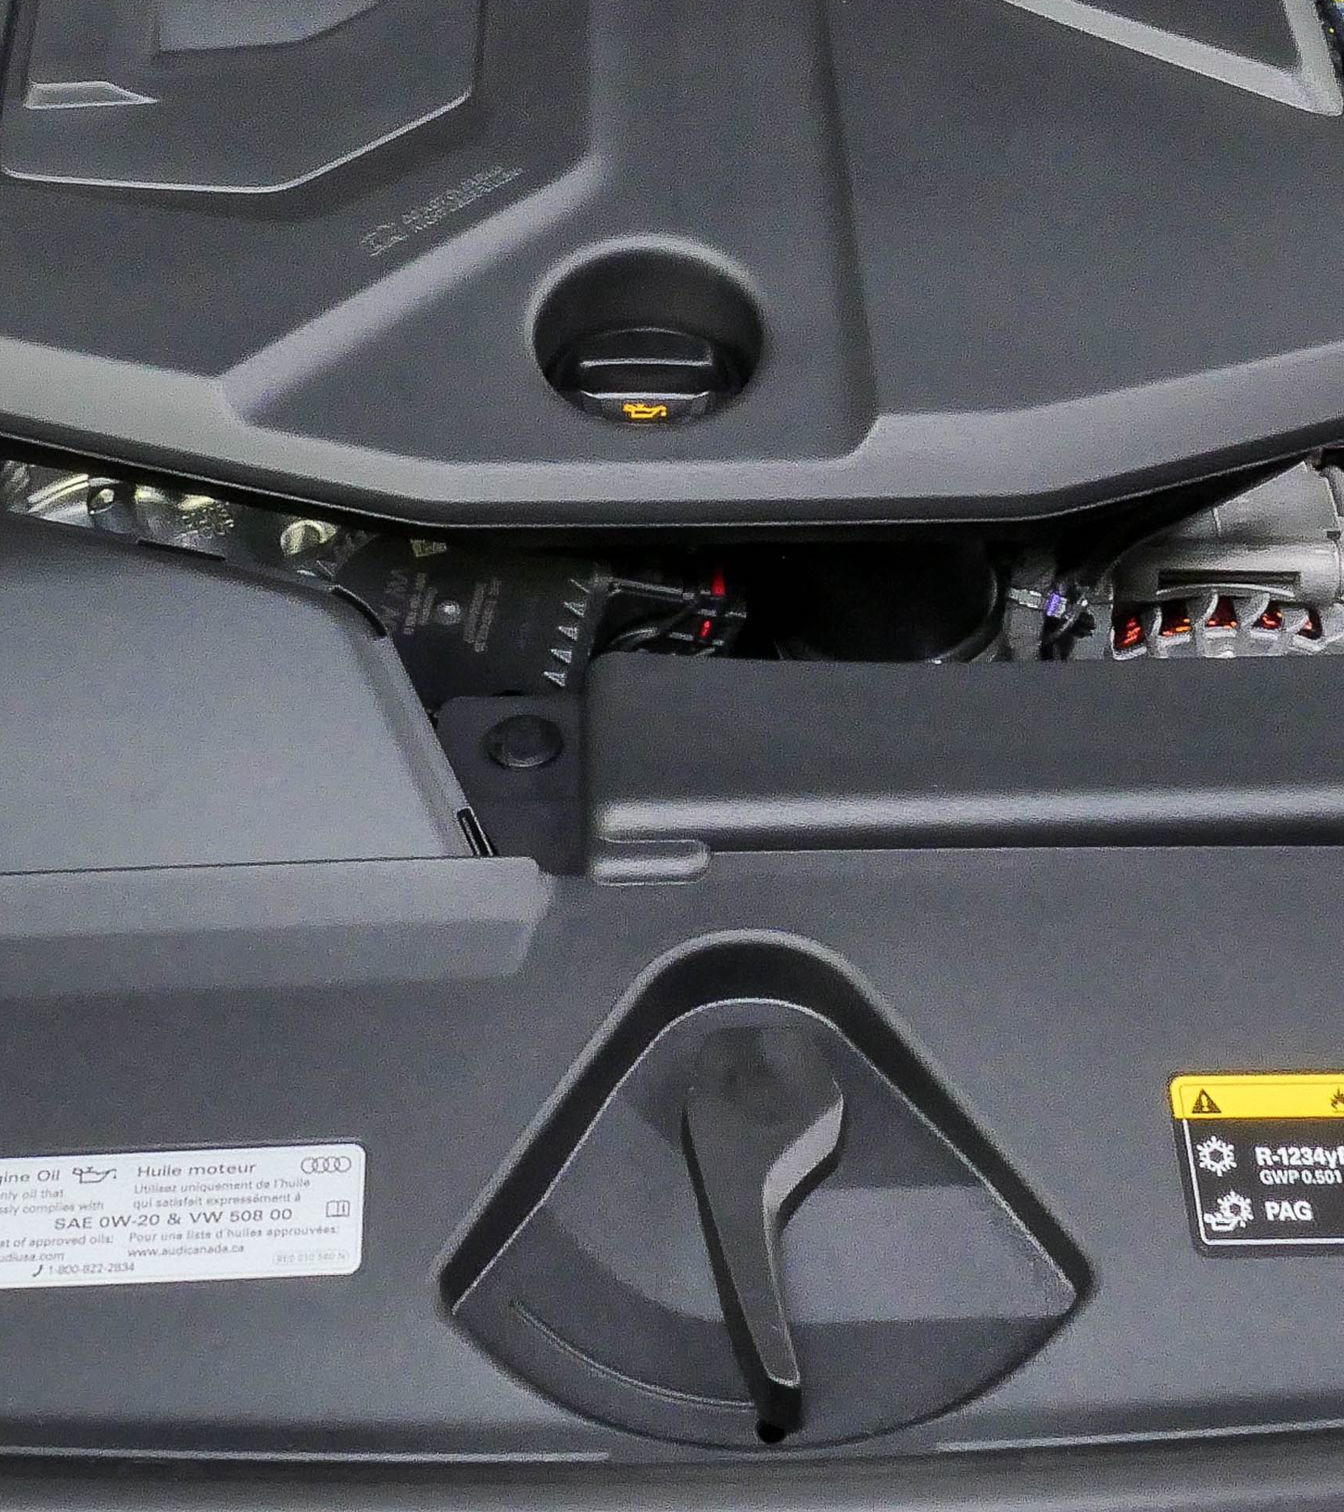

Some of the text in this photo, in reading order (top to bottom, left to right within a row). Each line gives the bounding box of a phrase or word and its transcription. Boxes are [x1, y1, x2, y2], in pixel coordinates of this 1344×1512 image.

[37, 1170, 60, 1183] Oil
[137, 1163, 256, 1177] Huile moteur
[1259, 1169, 1343, 1185] GWP 0.501
[180, 1180, 252, 1194] uniquement
[255, 1179, 270, 1189] de
[21, 1189, 37, 1200] oil
[41, 1188, 64, 1199] that
[22, 1201, 74, 1214] complies
[79, 1200, 104, 1211] with
[133, 1199, 152, 1210] qui
[155, 1196, 203, 1208] satisfait
[1265, 1201, 1313, 1221] PAG
[54, 1208, 292, 1230] SAE 0W-20 & VW 508 00
[13, 1237, 26, 1248] of
[29, 1235, 86, 1249] approved
[129, 1231, 156, 1242] Pour
[161, 1232, 182, 1241] une
[186, 1229, 212, 1240] liste
[127, 1244, 245, 1257] www.audicanada.ca
